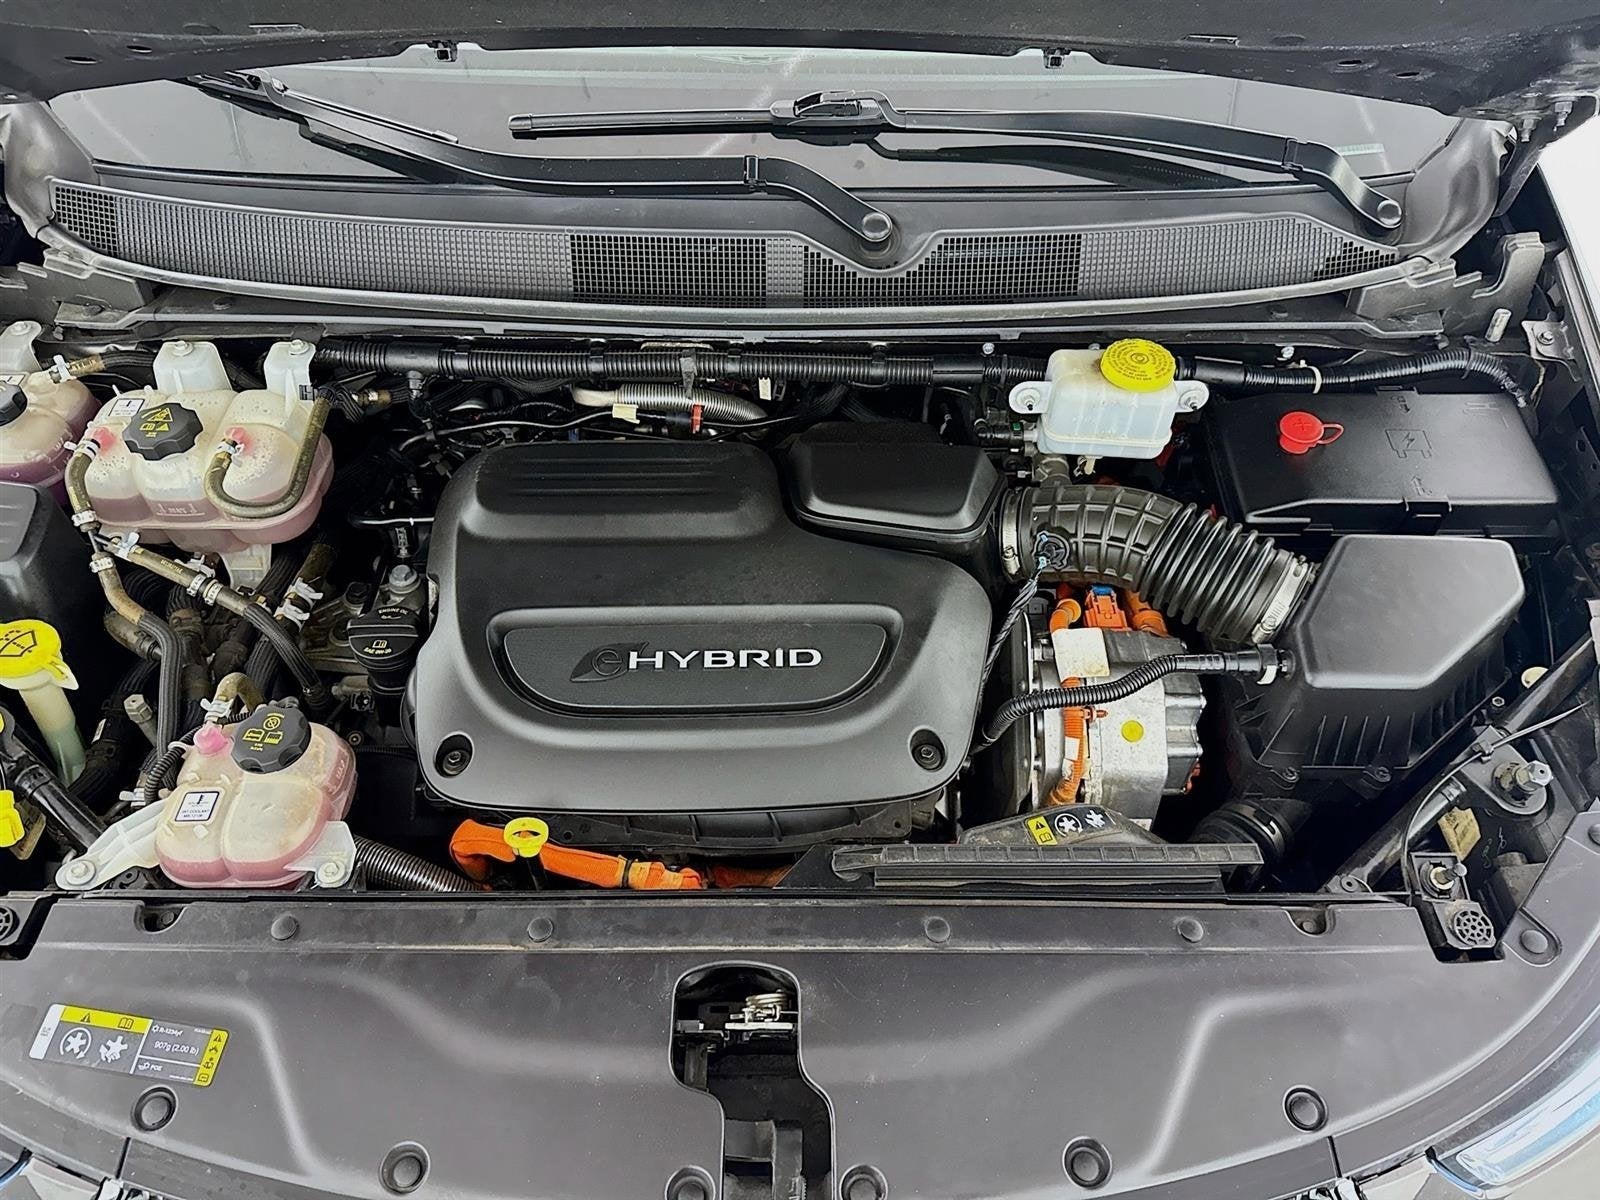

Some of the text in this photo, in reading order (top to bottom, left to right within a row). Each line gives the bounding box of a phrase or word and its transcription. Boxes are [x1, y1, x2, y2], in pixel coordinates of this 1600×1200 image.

[628, 648, 823, 670] HYBRID
[154, 1040, 200, 1056] 907g (2.00 lb)
